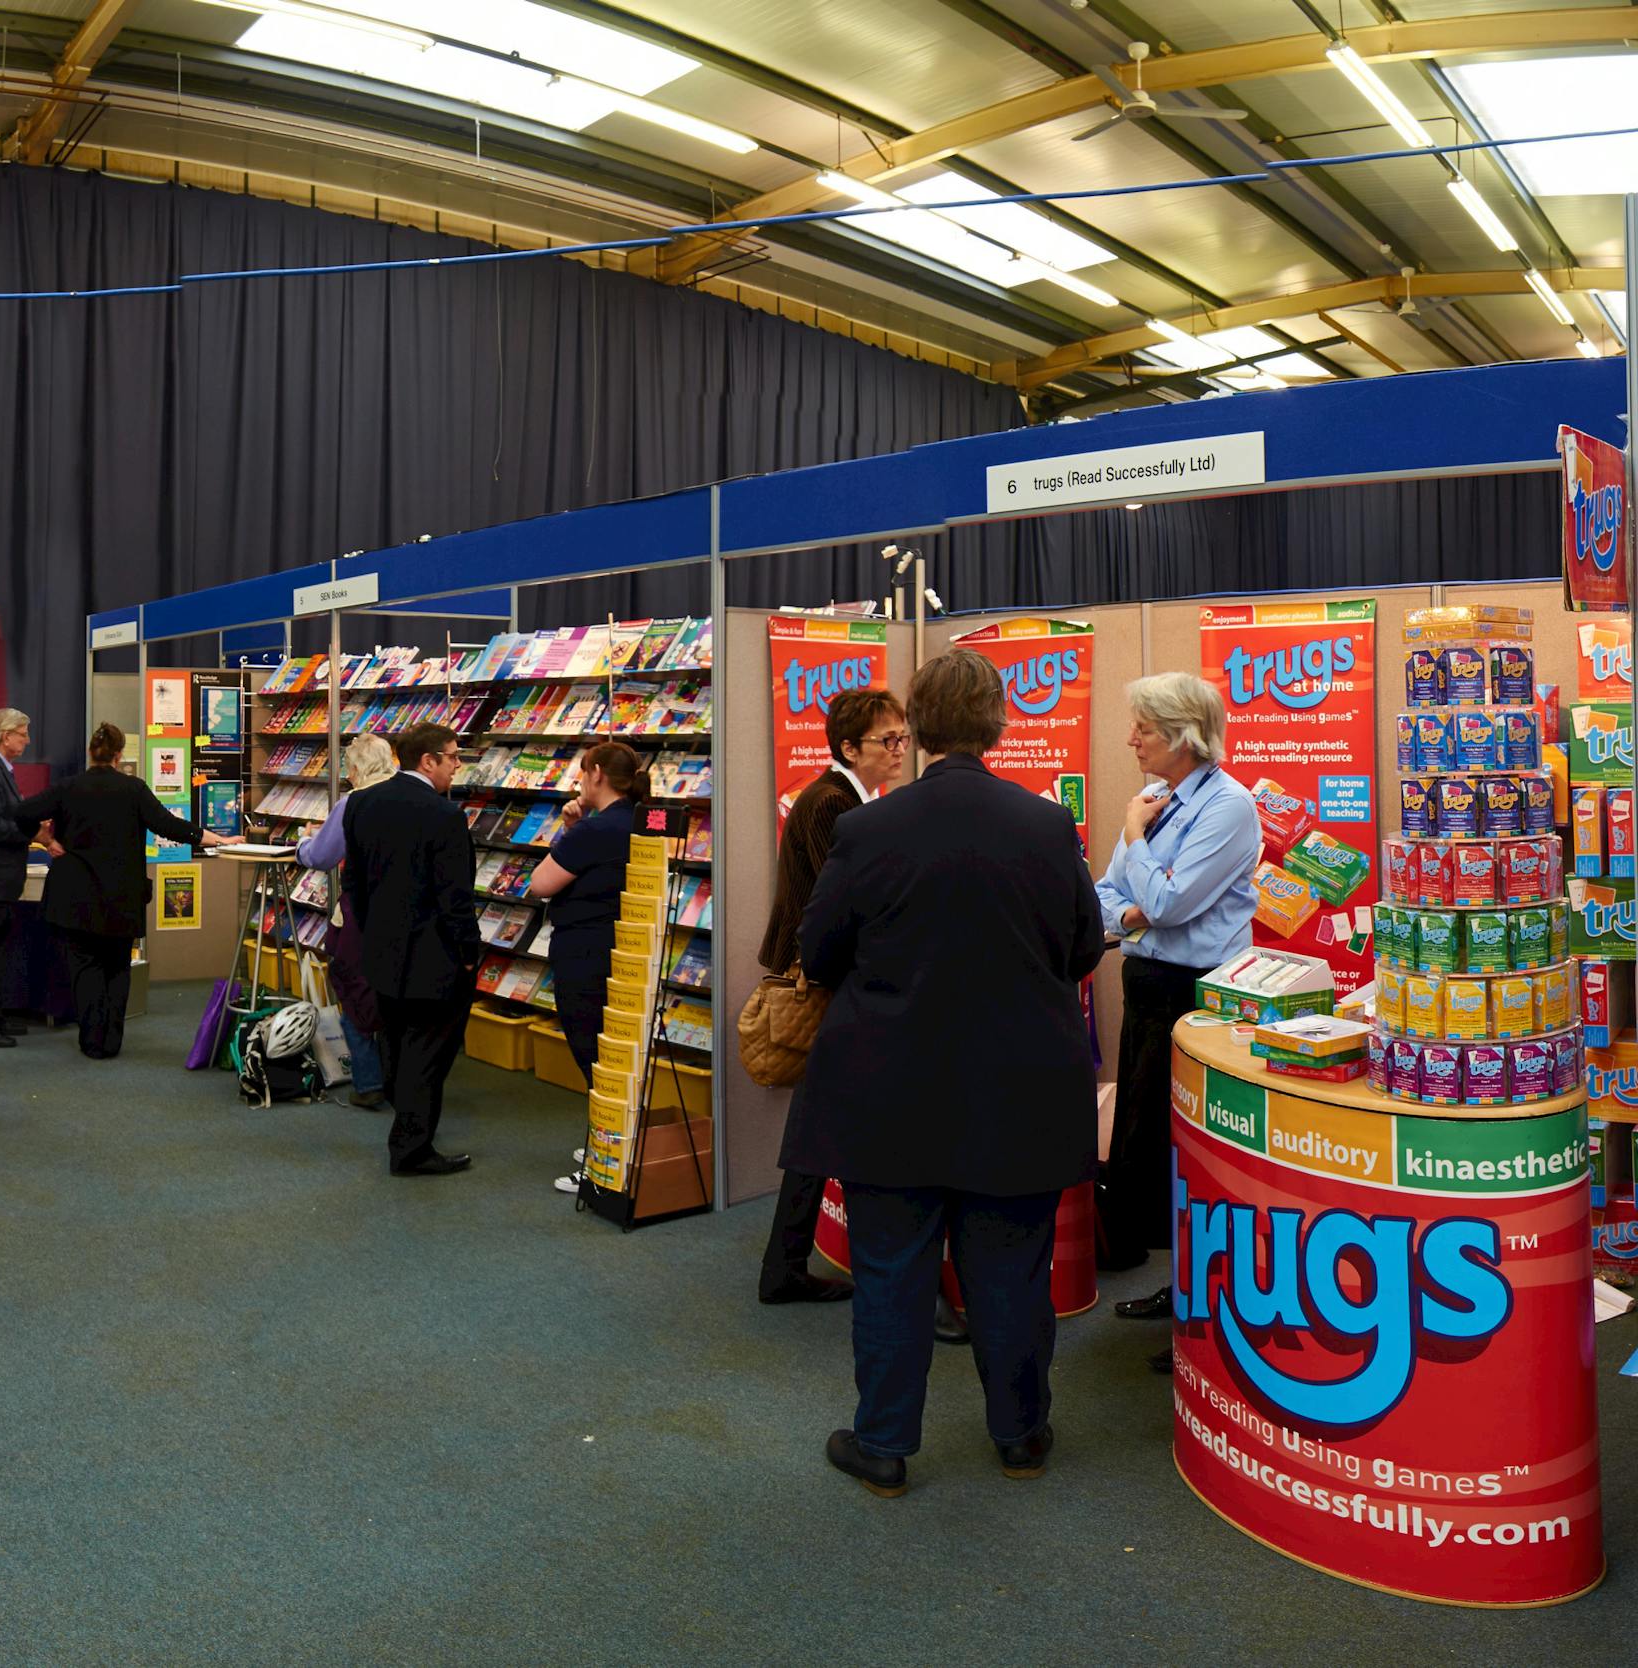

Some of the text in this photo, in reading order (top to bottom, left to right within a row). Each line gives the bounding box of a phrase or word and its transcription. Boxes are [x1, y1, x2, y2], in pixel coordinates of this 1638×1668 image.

[1007, 453, 1215, 494] 6 trugs (Read Successfully Ltd)
[320, 591, 331, 602] SEN
[331, 589, 348, 600] Books
[1224, 636, 1355, 709] trugs
[1293, 679, 1353, 692] at home
[1227, 711, 1352, 724] teach reading using games
[1001, 738, 1047, 748] tricky words
[1235, 740, 1348, 752] A high quality synthetic
[1232, 752, 1353, 764] phonics reading resource
[1325, 779, 1364, 788] for home
[1336, 789, 1354, 798] and
[1322, 800, 1369, 808] one-to-one
[1326, 808, 1364, 819] teaching
[1208, 1102, 1255, 1139] visual
[1271, 1128, 1378, 1175] auditory
[1405, 1140, 1587, 1180] kinaesthetic
[1174, 1351, 1197, 1391] each
[1201, 1378, 1274, 1446] reading
[1282, 1426, 1361, 1479] using
[1374, 1454, 1502, 1497] games
